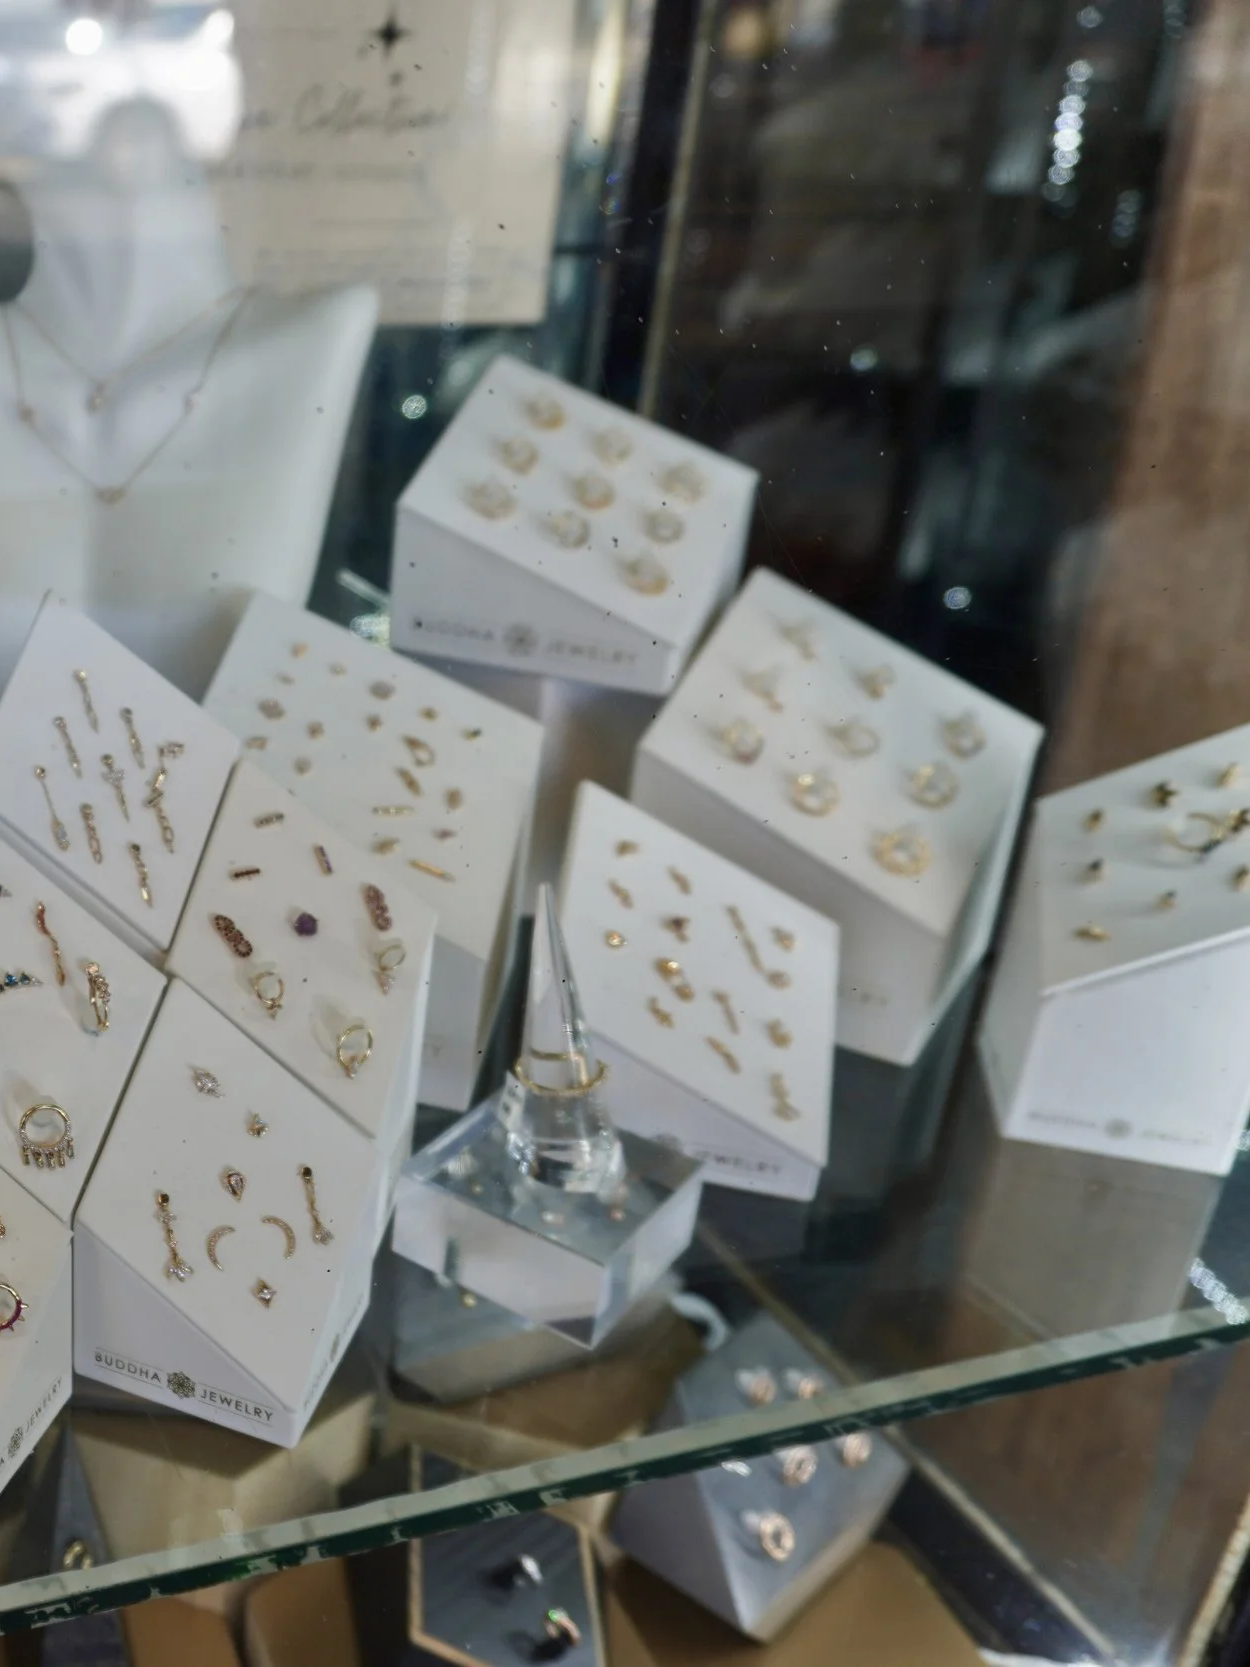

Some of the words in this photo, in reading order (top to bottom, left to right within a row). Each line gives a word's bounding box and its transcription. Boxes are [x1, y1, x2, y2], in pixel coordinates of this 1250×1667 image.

[25, 1375, 62, 1433] JEWELRY
[94, 1351, 162, 1384] BUDDHA
[200, 1389, 274, 1423] JEWELRY
